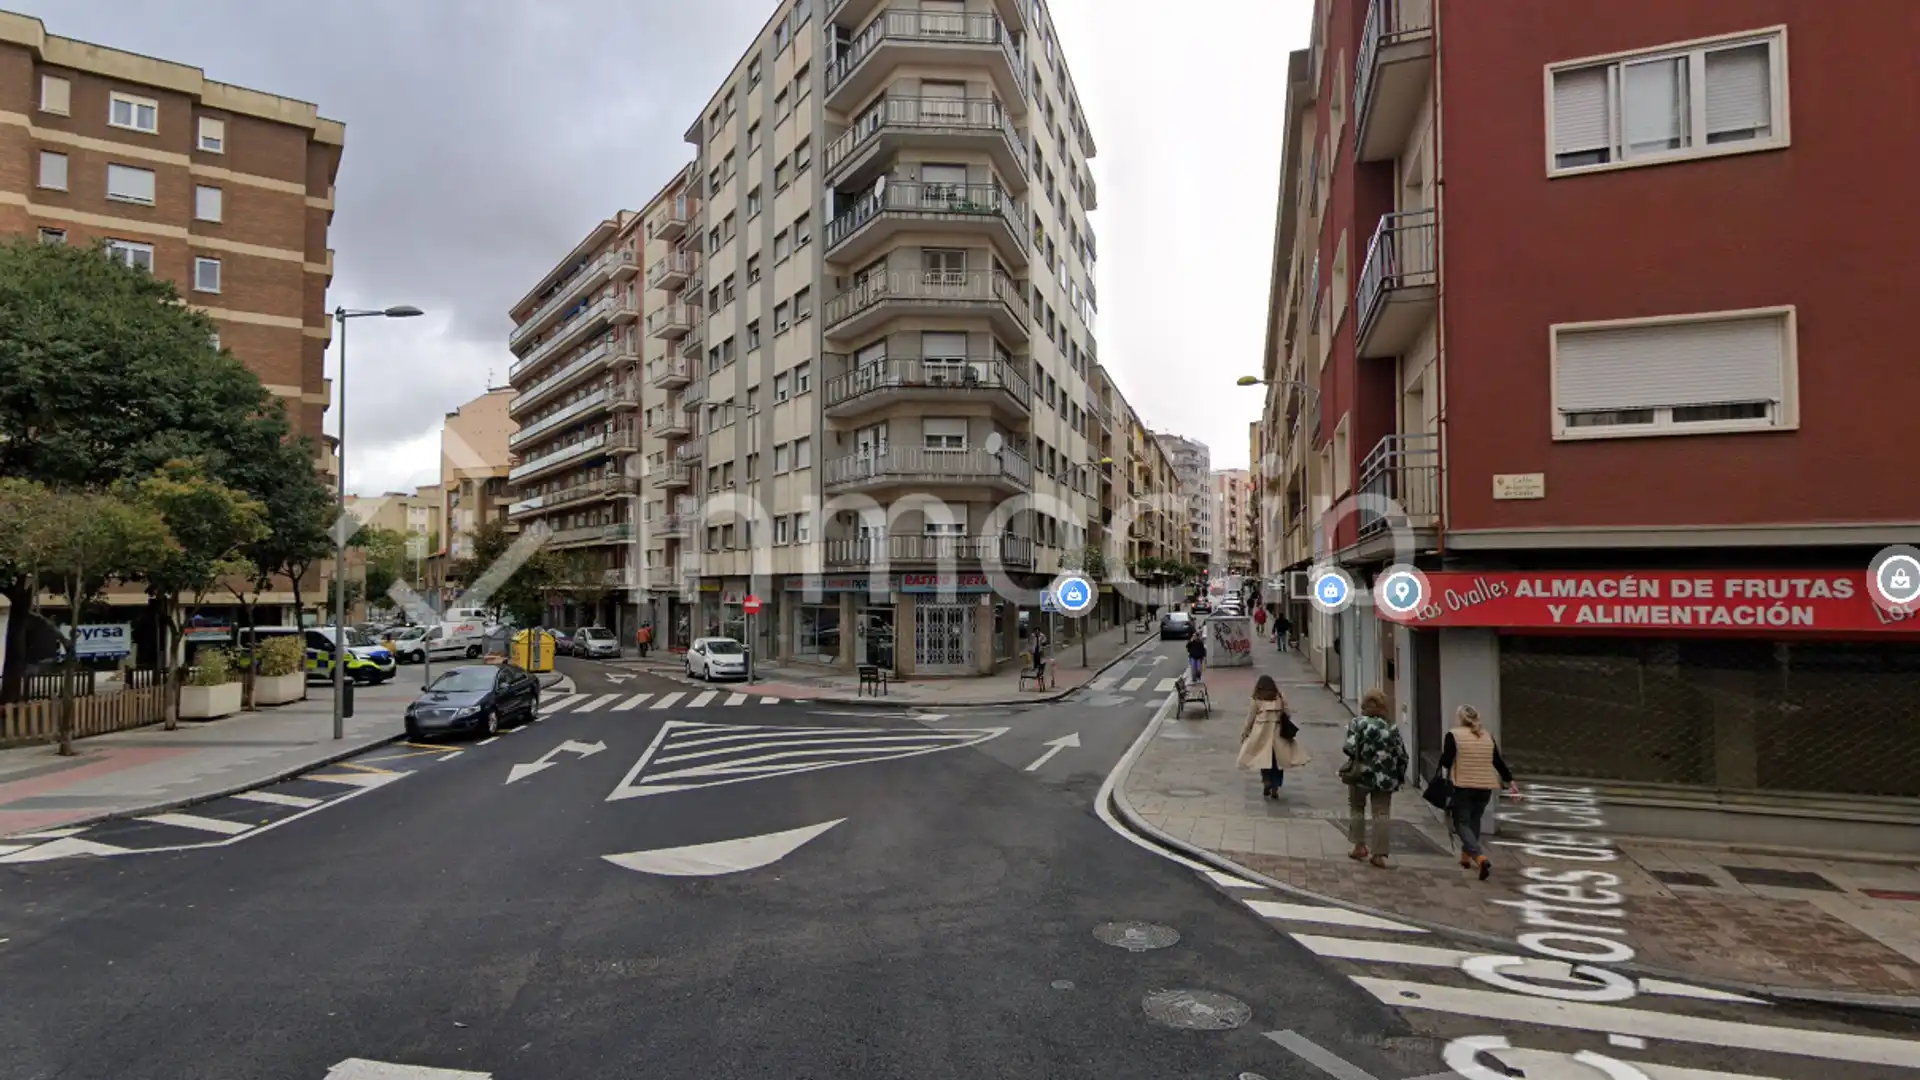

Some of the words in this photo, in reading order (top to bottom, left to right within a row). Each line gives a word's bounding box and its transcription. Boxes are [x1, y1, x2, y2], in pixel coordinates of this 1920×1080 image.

[1444, 576, 1510, 611] Ovalles
[1514, 575, 1660, 598] ALMACÉN
[1671, 579, 1714, 598] DE
[1725, 578, 1854, 598] FRUTAS
[1547, 604, 1568, 623] Y
[1576, 601, 1815, 625] ALIMENTACIÓN
